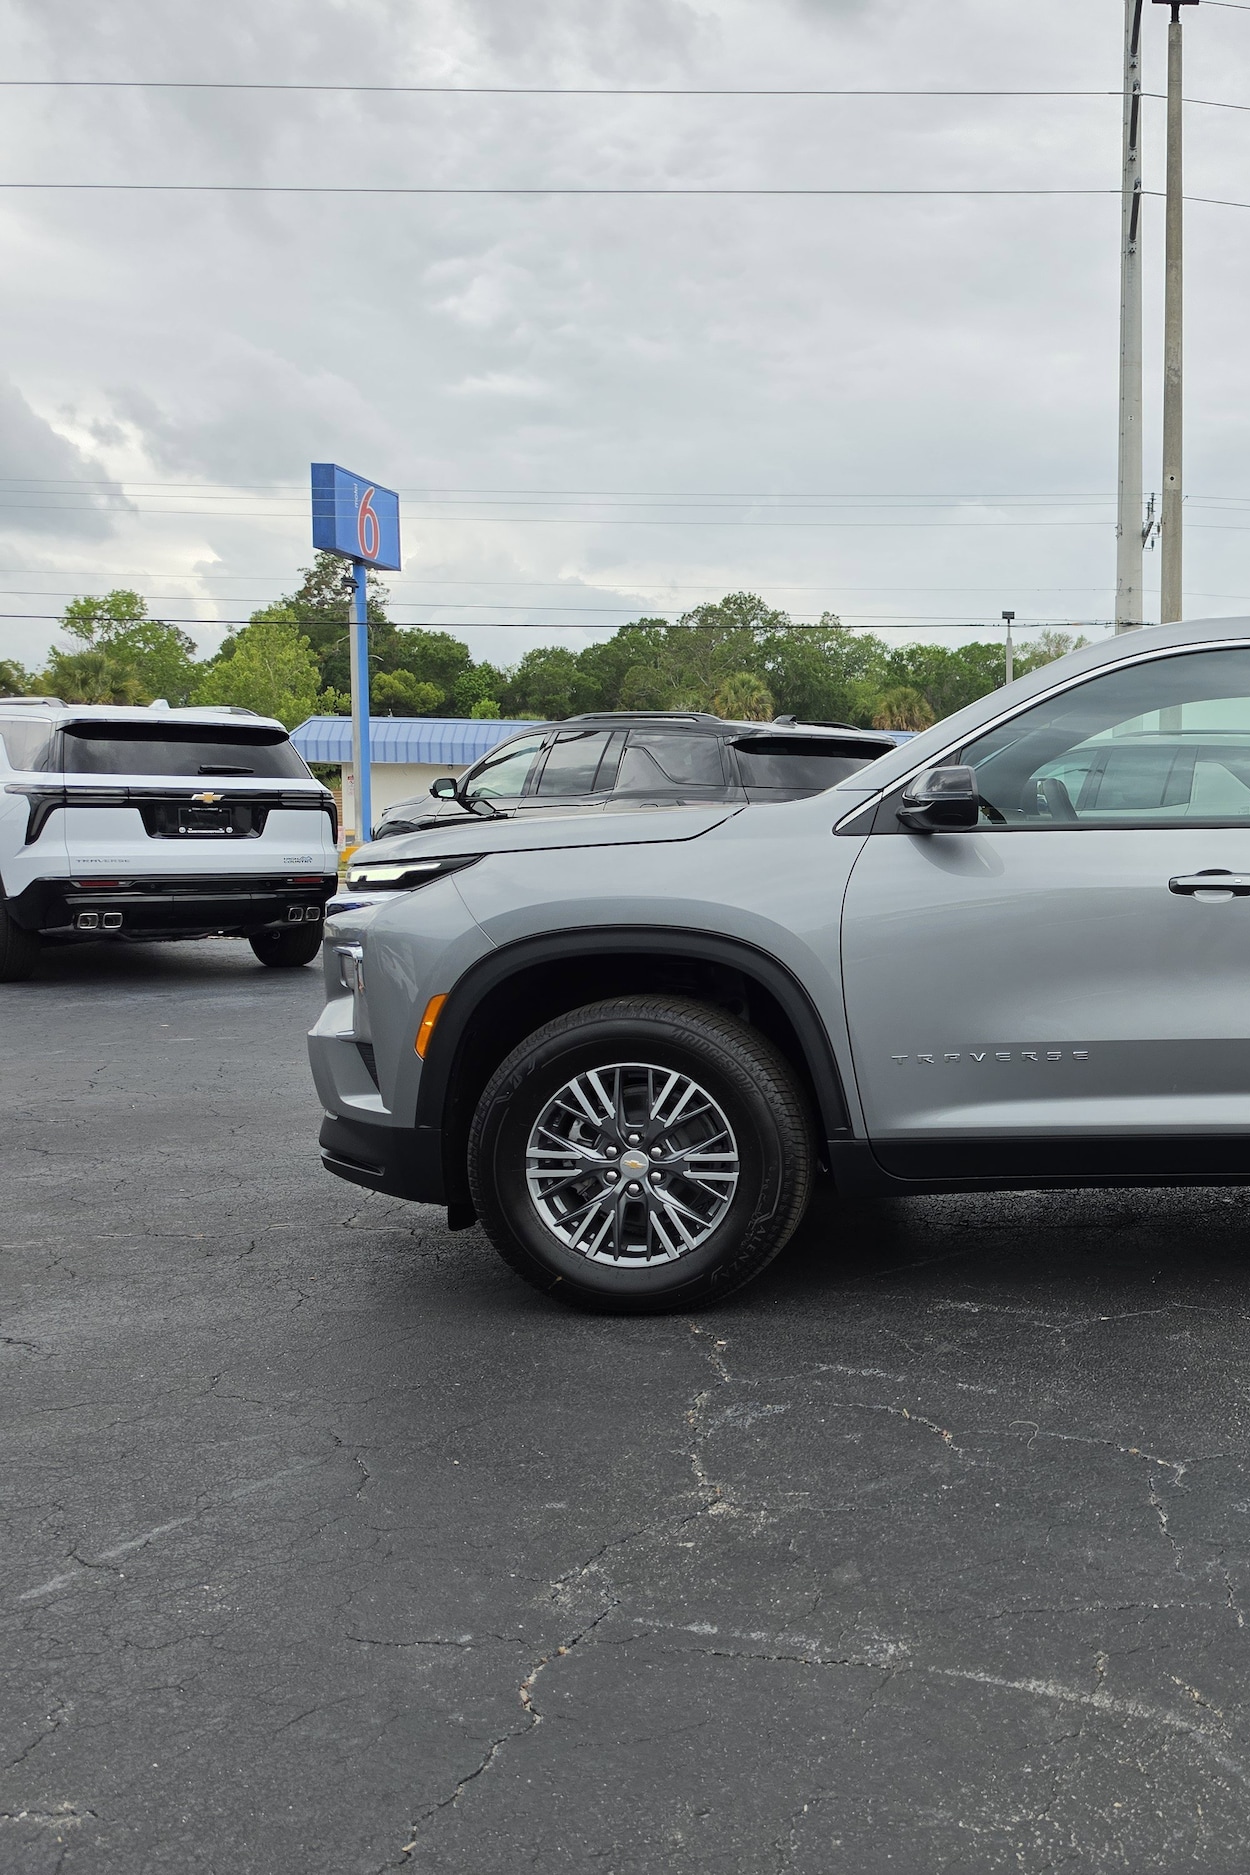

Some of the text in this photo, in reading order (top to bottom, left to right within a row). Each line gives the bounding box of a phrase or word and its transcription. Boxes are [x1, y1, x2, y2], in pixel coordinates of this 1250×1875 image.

[357, 486, 380, 560] 6
[672, 1028, 761, 1098] BRIDGESTONE
[891, 1051, 1089, 1064] TRAVERSE
[721, 1225, 766, 1277] ALENZA
